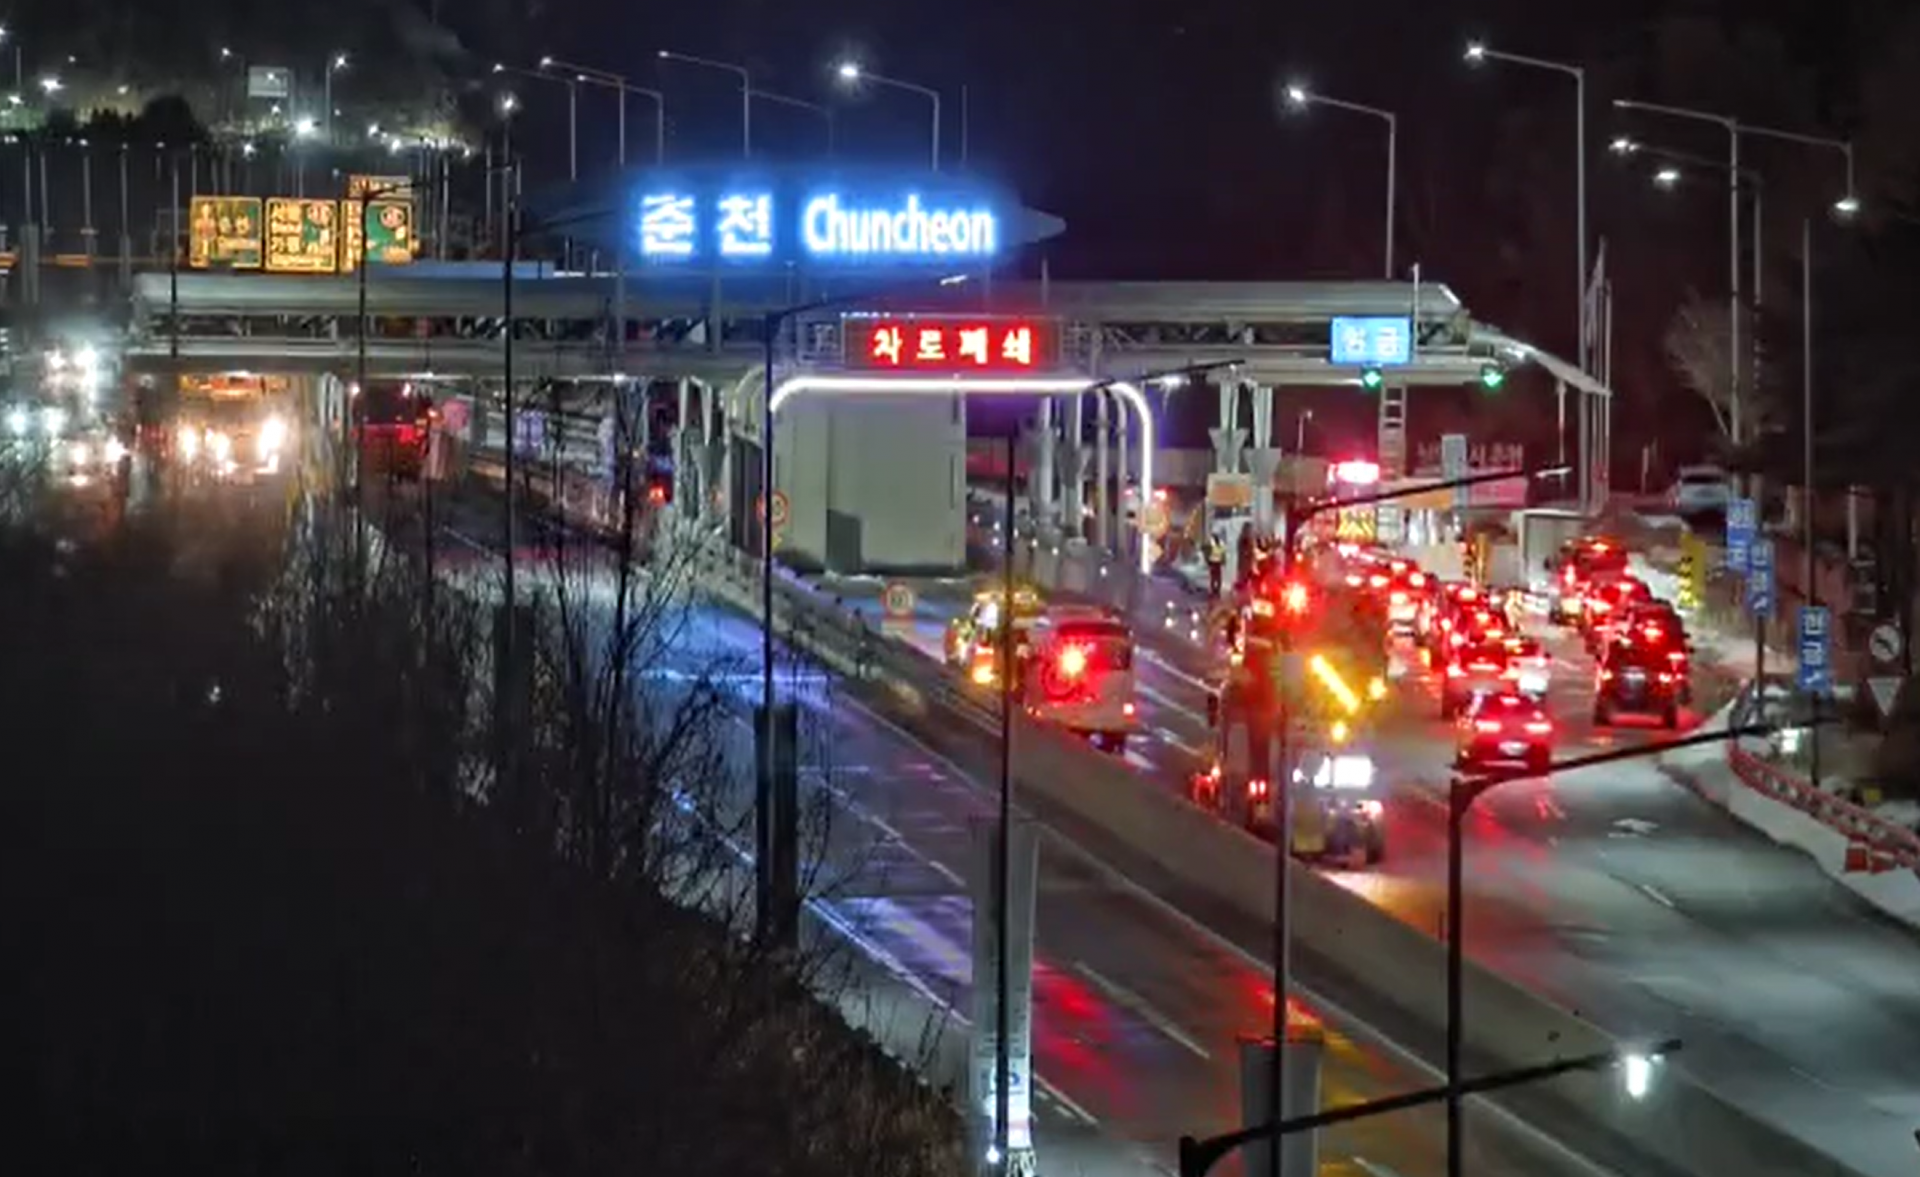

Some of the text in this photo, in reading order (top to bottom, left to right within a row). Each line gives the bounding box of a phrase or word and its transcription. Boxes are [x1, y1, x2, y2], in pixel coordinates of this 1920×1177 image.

[642, 193, 995, 254] 춘천 Chuncheon
[873, 326, 1031, 365] 차로폐쇄
